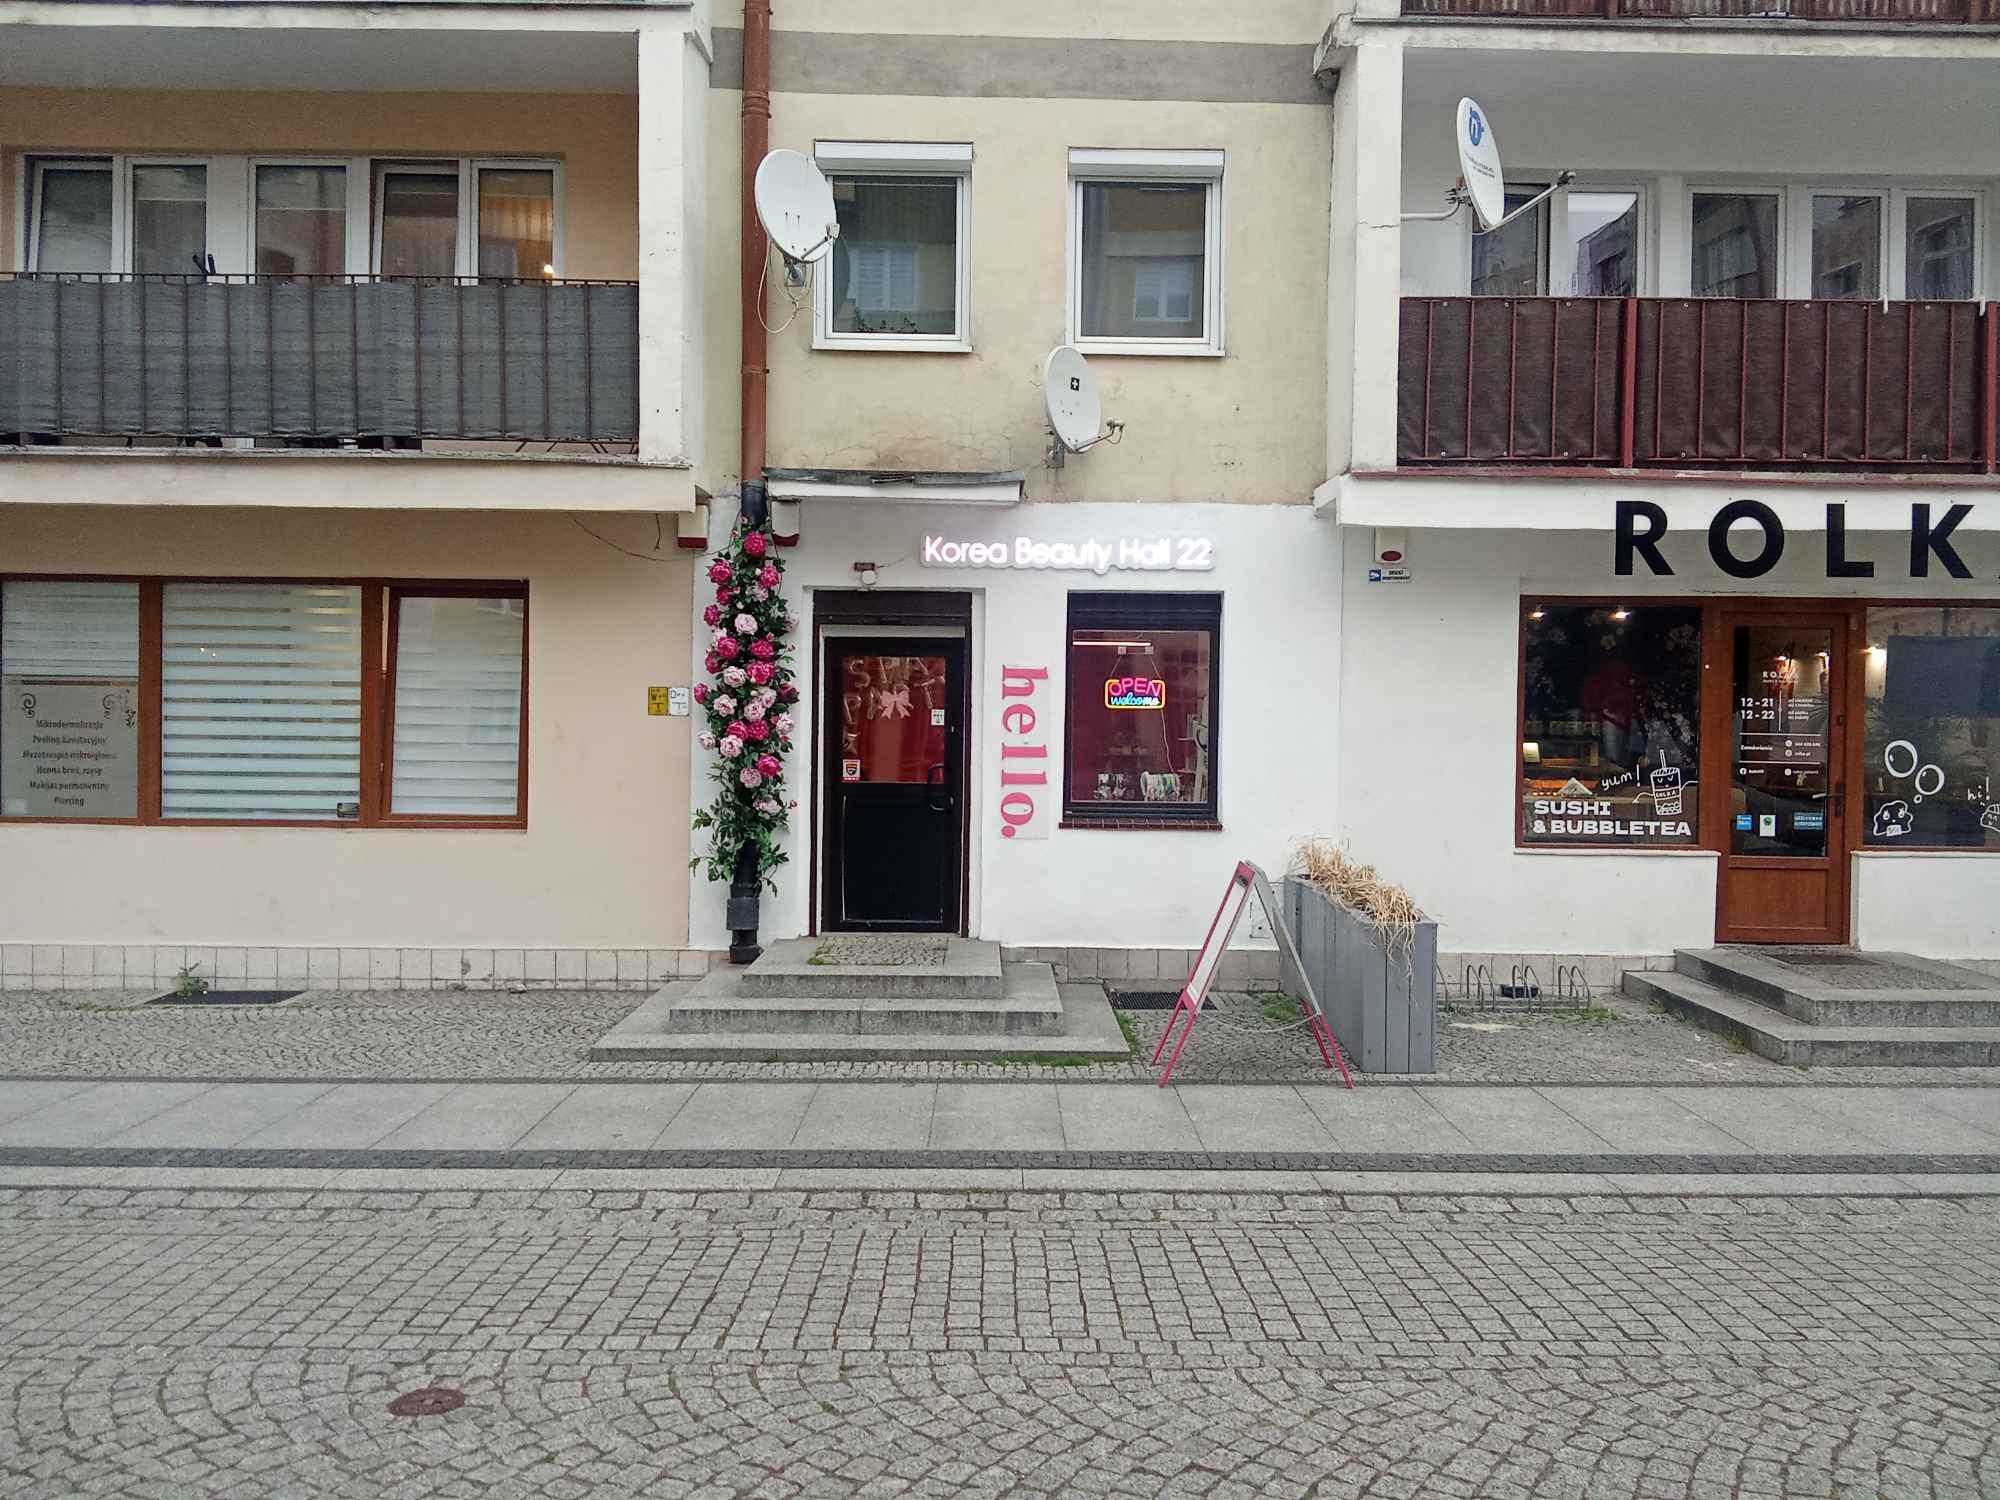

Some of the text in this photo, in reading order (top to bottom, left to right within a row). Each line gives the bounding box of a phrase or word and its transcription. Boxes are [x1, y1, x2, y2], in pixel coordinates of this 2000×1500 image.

[1614, 499, 2000, 578] ROLK
[925, 536, 1211, 570] Korea Beauty Hall 22
[1109, 678, 1162, 697] OPEN
[1110, 692, 1160, 706] welcome
[1001, 664, 1049, 838] hello.
[1601, 764, 1641, 791] yum!
[1967, 776, 1990, 801] hi!
[1534, 800, 1611, 815] SUSHI
[1550, 819, 1692, 836] BUBBLETEA
